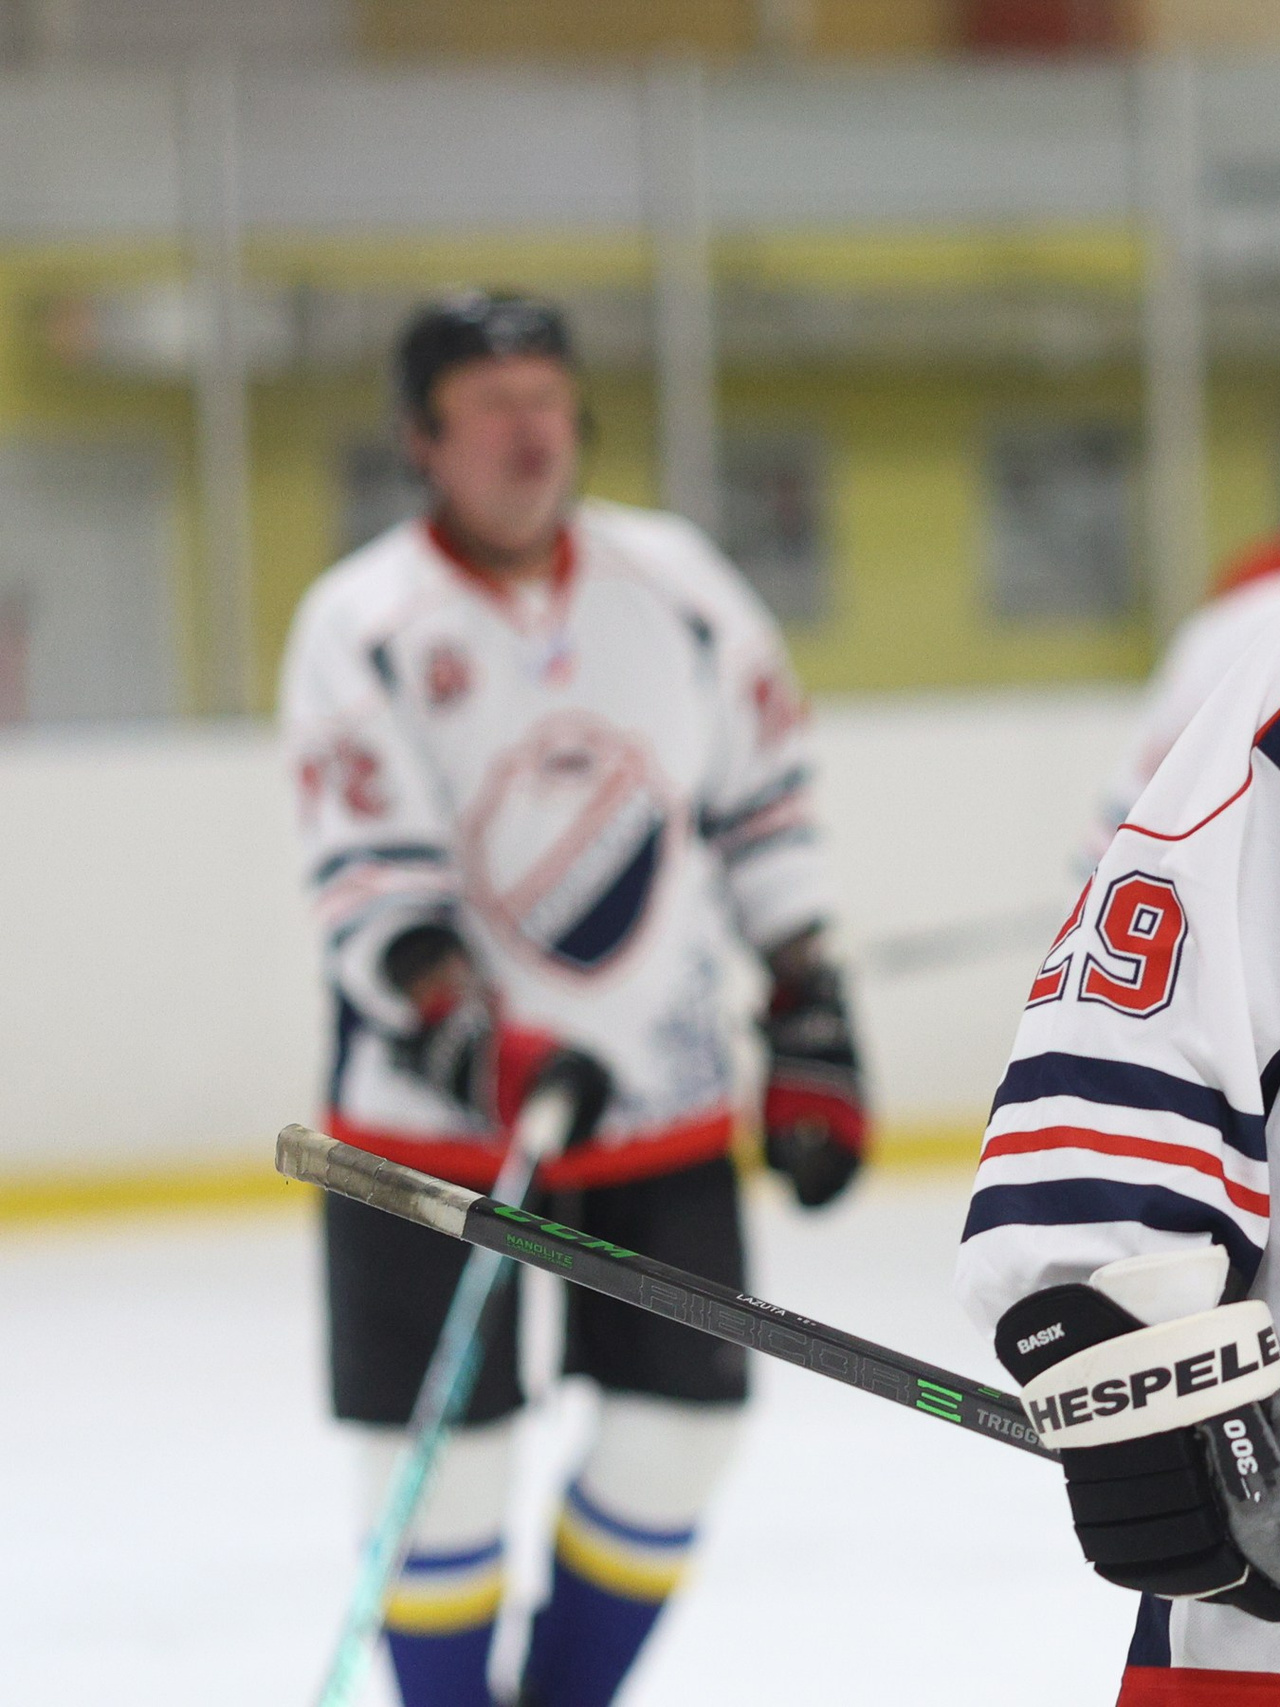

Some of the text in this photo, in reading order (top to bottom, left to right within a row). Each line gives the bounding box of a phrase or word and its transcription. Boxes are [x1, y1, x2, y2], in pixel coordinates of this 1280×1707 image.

[494, 1205, 640, 1258] CCM
[505, 1232, 574, 1264] NANOLITE
[736, 1293, 786, 1317] LAZUTA
[638, 1273, 911, 1406] RIBCOR
[1016, 1322, 1066, 1355] BASIX
